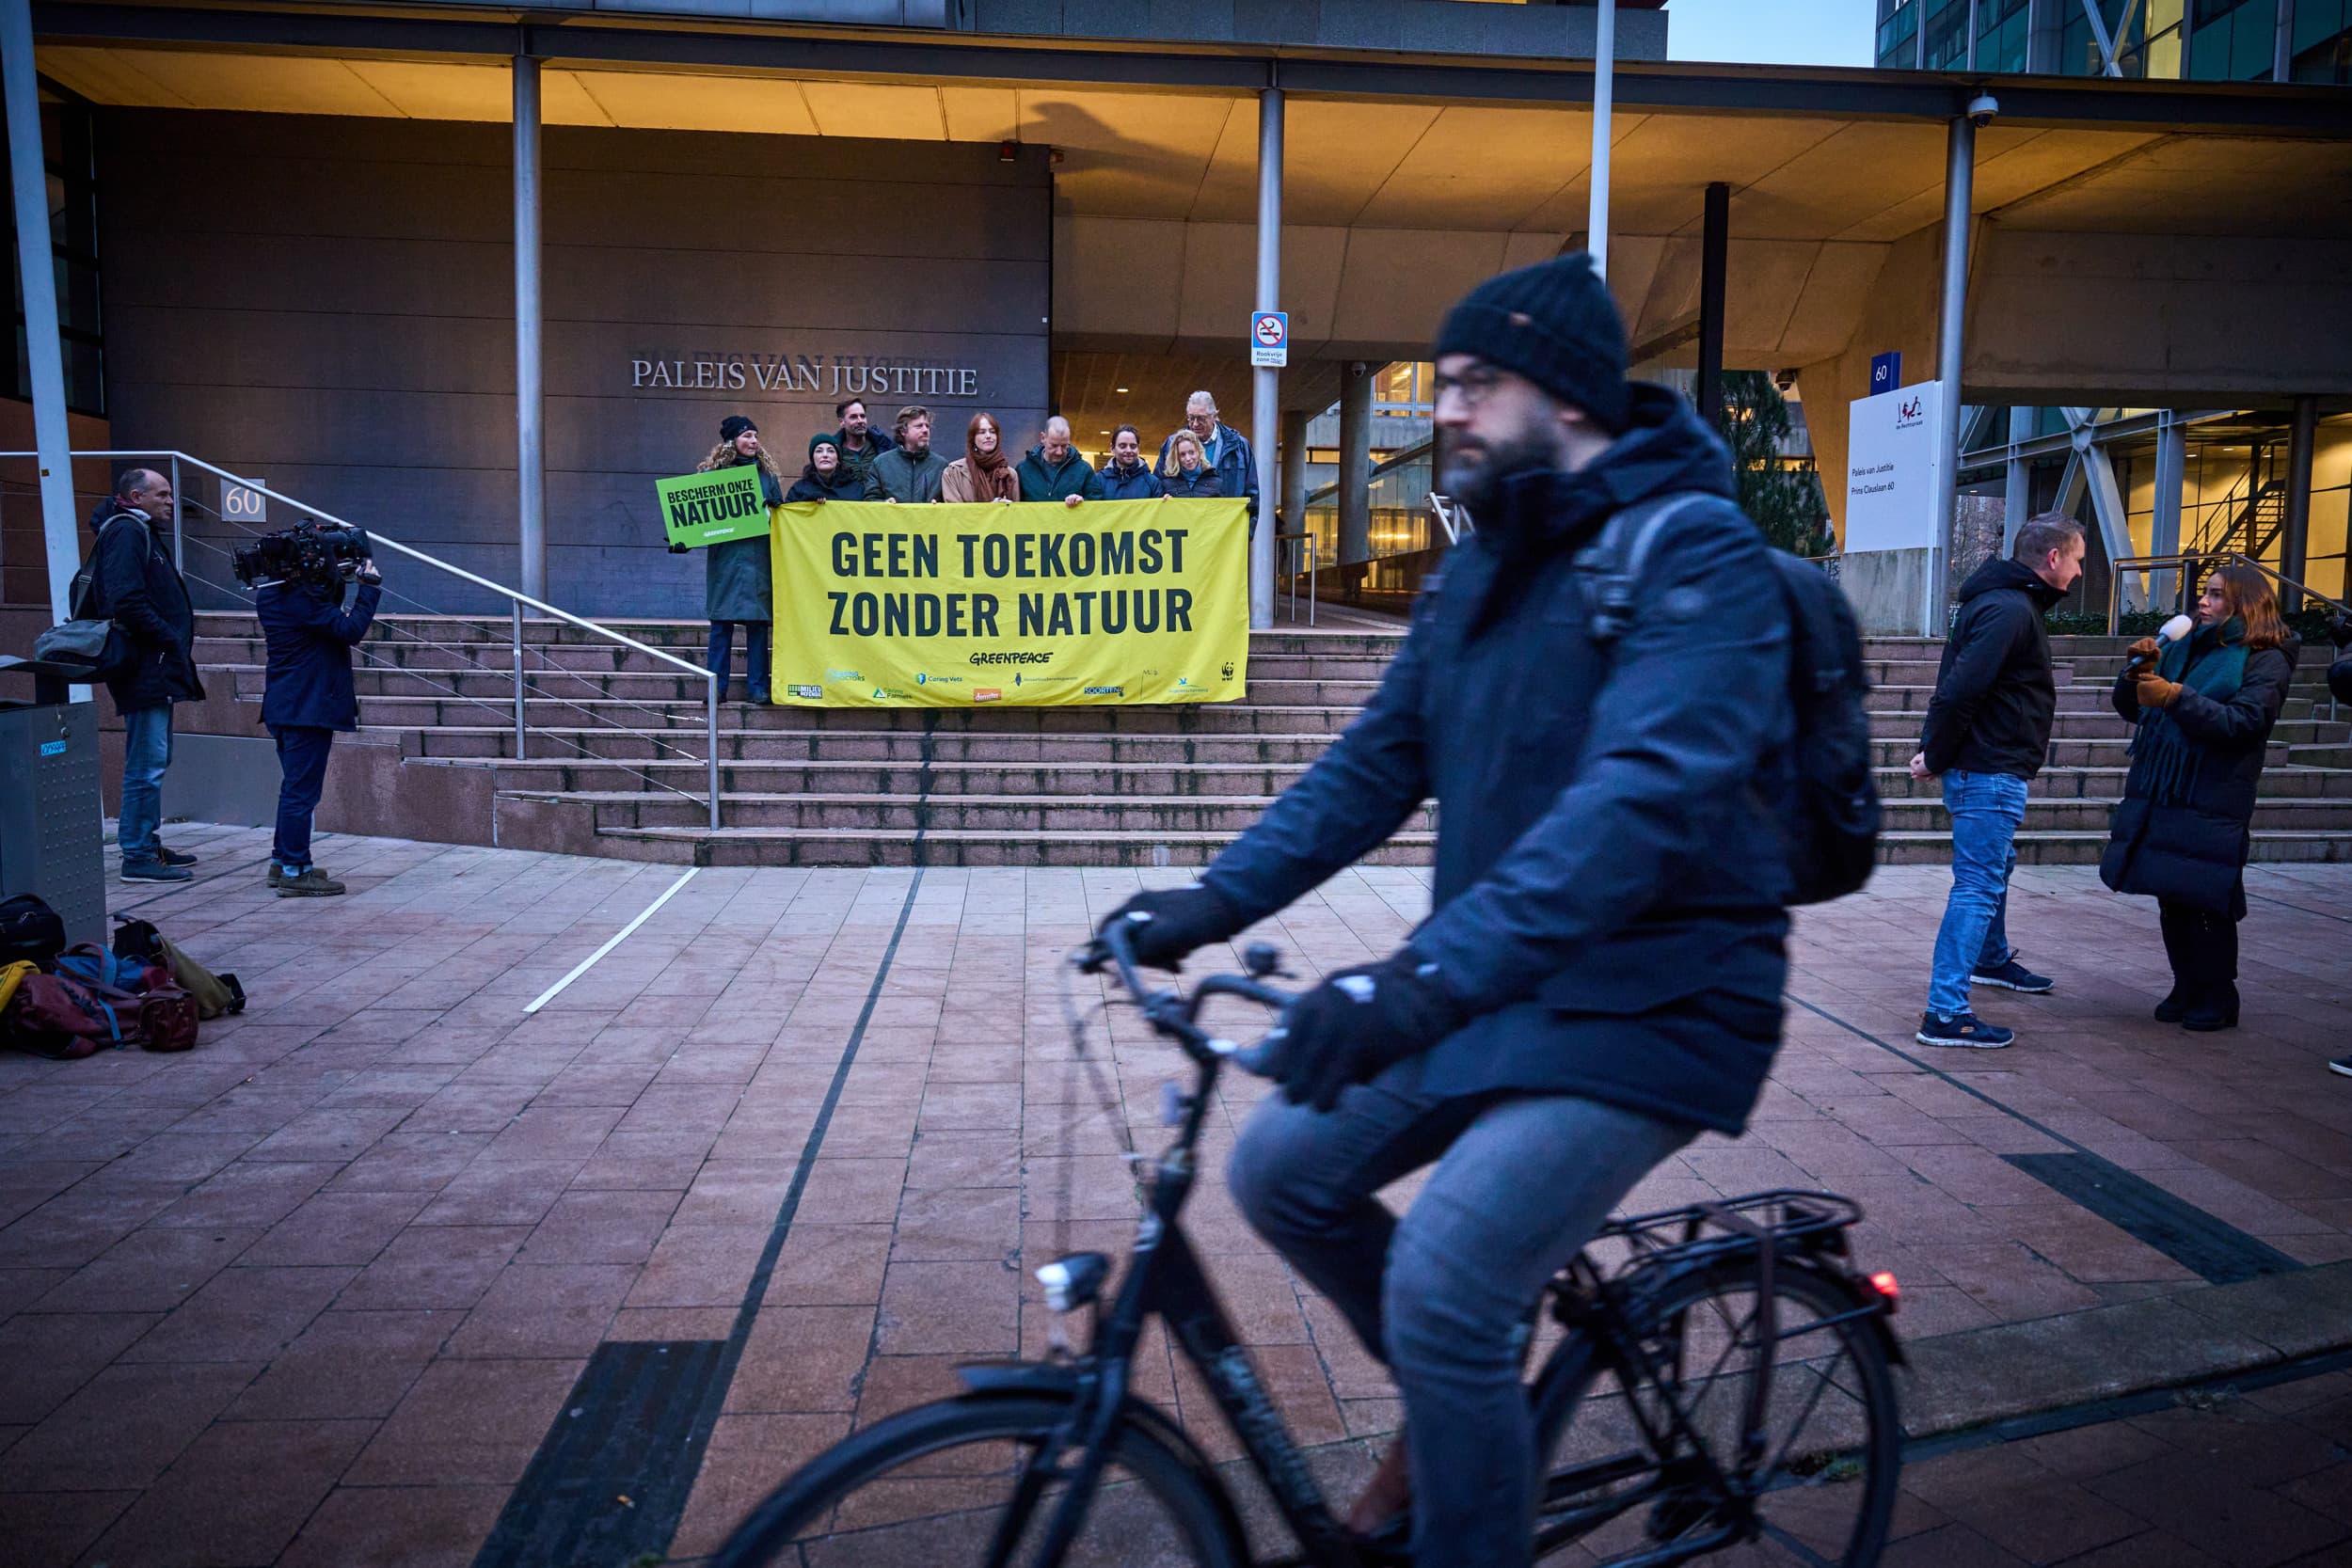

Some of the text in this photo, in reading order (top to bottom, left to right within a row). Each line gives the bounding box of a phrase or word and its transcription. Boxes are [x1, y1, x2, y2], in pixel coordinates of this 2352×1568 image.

[631, 360, 978, 396] PALEIS VAN JUSTITIE
[1875, 365, 1887, 382] 60
[1851, 467, 1866, 477] Paleis
[1876, 462, 1895, 474] Justitie
[226, 486, 261, 515] 60
[667, 479, 755, 503] BESCHERM ONZE
[1851, 481, 1895, 496] Prins Clauslaan 60
[670, 492, 759, 528] NATUUR
[832, 529, 1188, 578] GEEN TOEKOMST
[827, 588, 1193, 637] ZONDER NATUUR
[969, 652, 1054, 666] GREENPEACE
[928, 675, 948, 684] Caring
